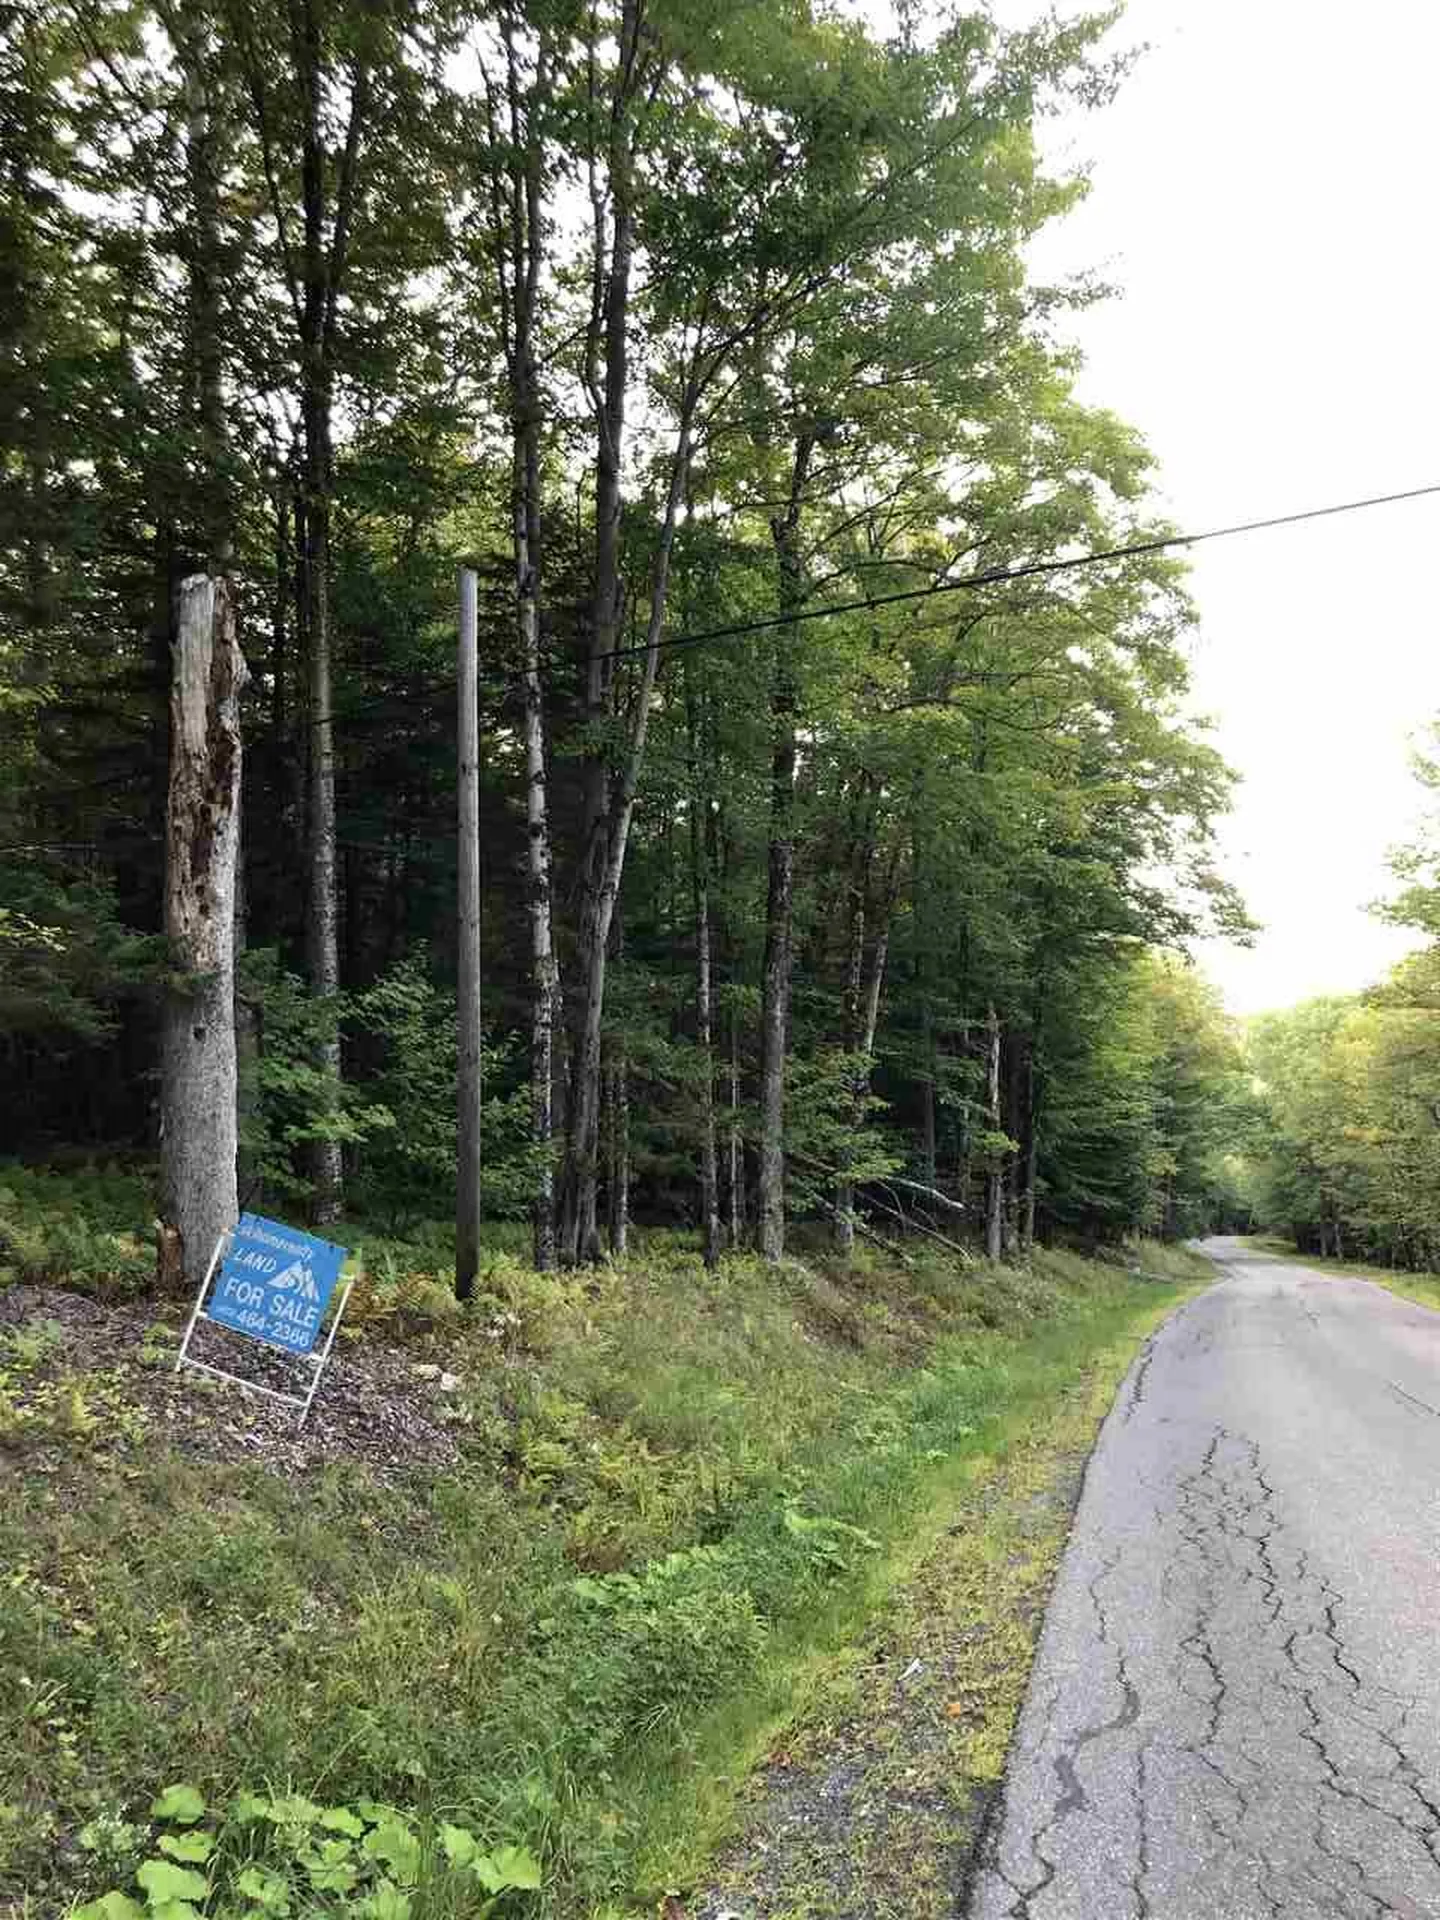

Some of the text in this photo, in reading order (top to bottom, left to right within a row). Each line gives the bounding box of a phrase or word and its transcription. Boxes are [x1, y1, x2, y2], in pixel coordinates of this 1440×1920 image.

[233, 1248, 277, 1273] LAND
[224, 1277, 265, 1308] FOR
[269, 1294, 319, 1328] SALE
